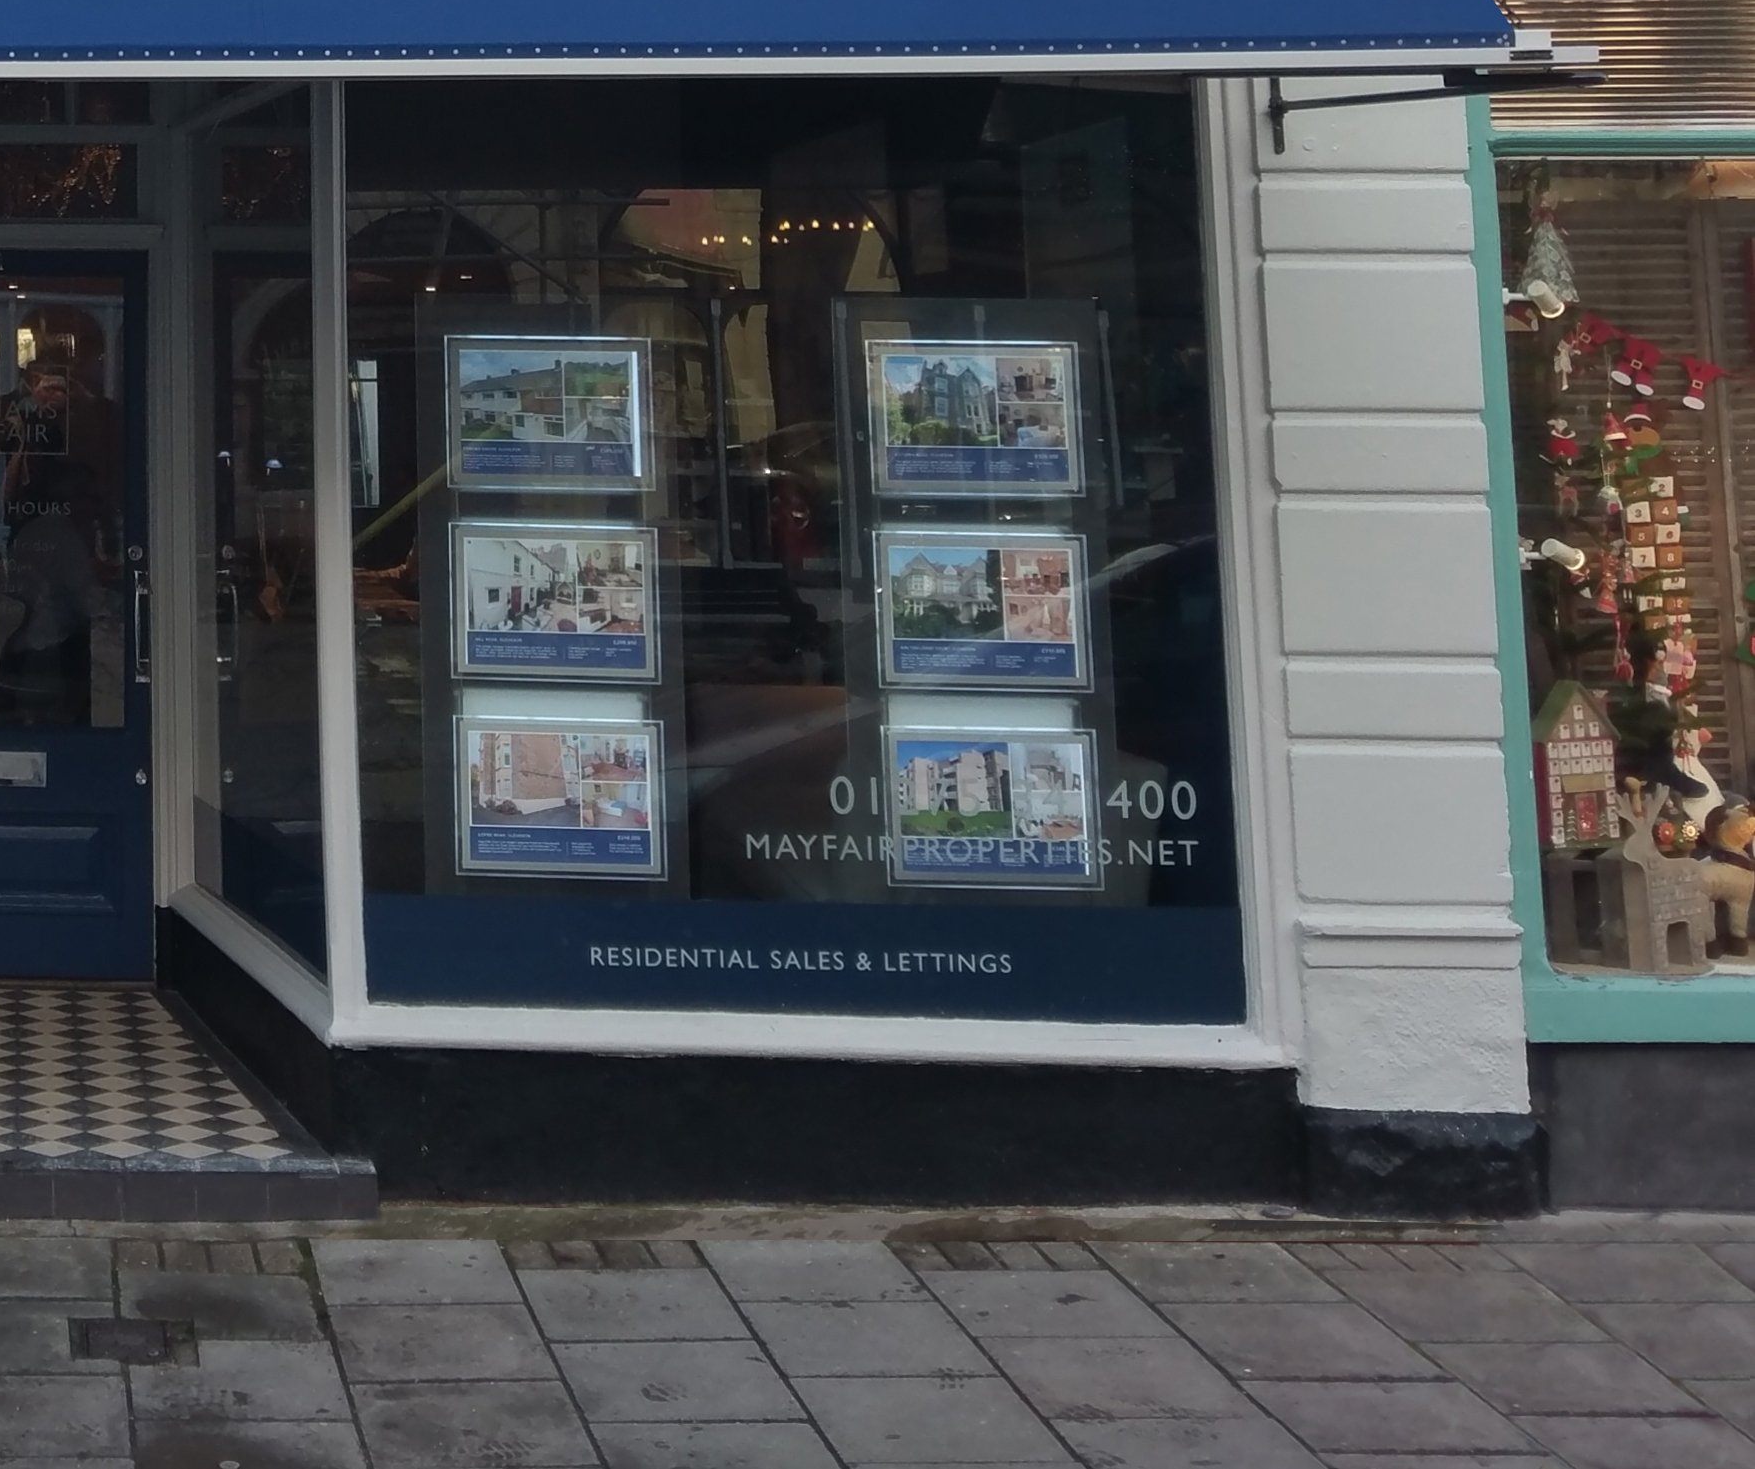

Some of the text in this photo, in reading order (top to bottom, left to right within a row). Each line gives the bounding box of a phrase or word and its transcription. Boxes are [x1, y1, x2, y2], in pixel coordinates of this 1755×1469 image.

[1658, 484, 1666, 493] 2
[6, 501, 72, 515] HOURS
[1661, 506, 1670, 516] 4
[1634, 509, 1642, 518] 3
[1638, 532, 1646, 541] 5
[1666, 530, 1674, 539] 6
[1640, 554, 1647, 564] 7
[1666, 552, 1675, 562] 8
[589, 946, 1012, 974] RESIDENTIAL SALES & LETTINGS
